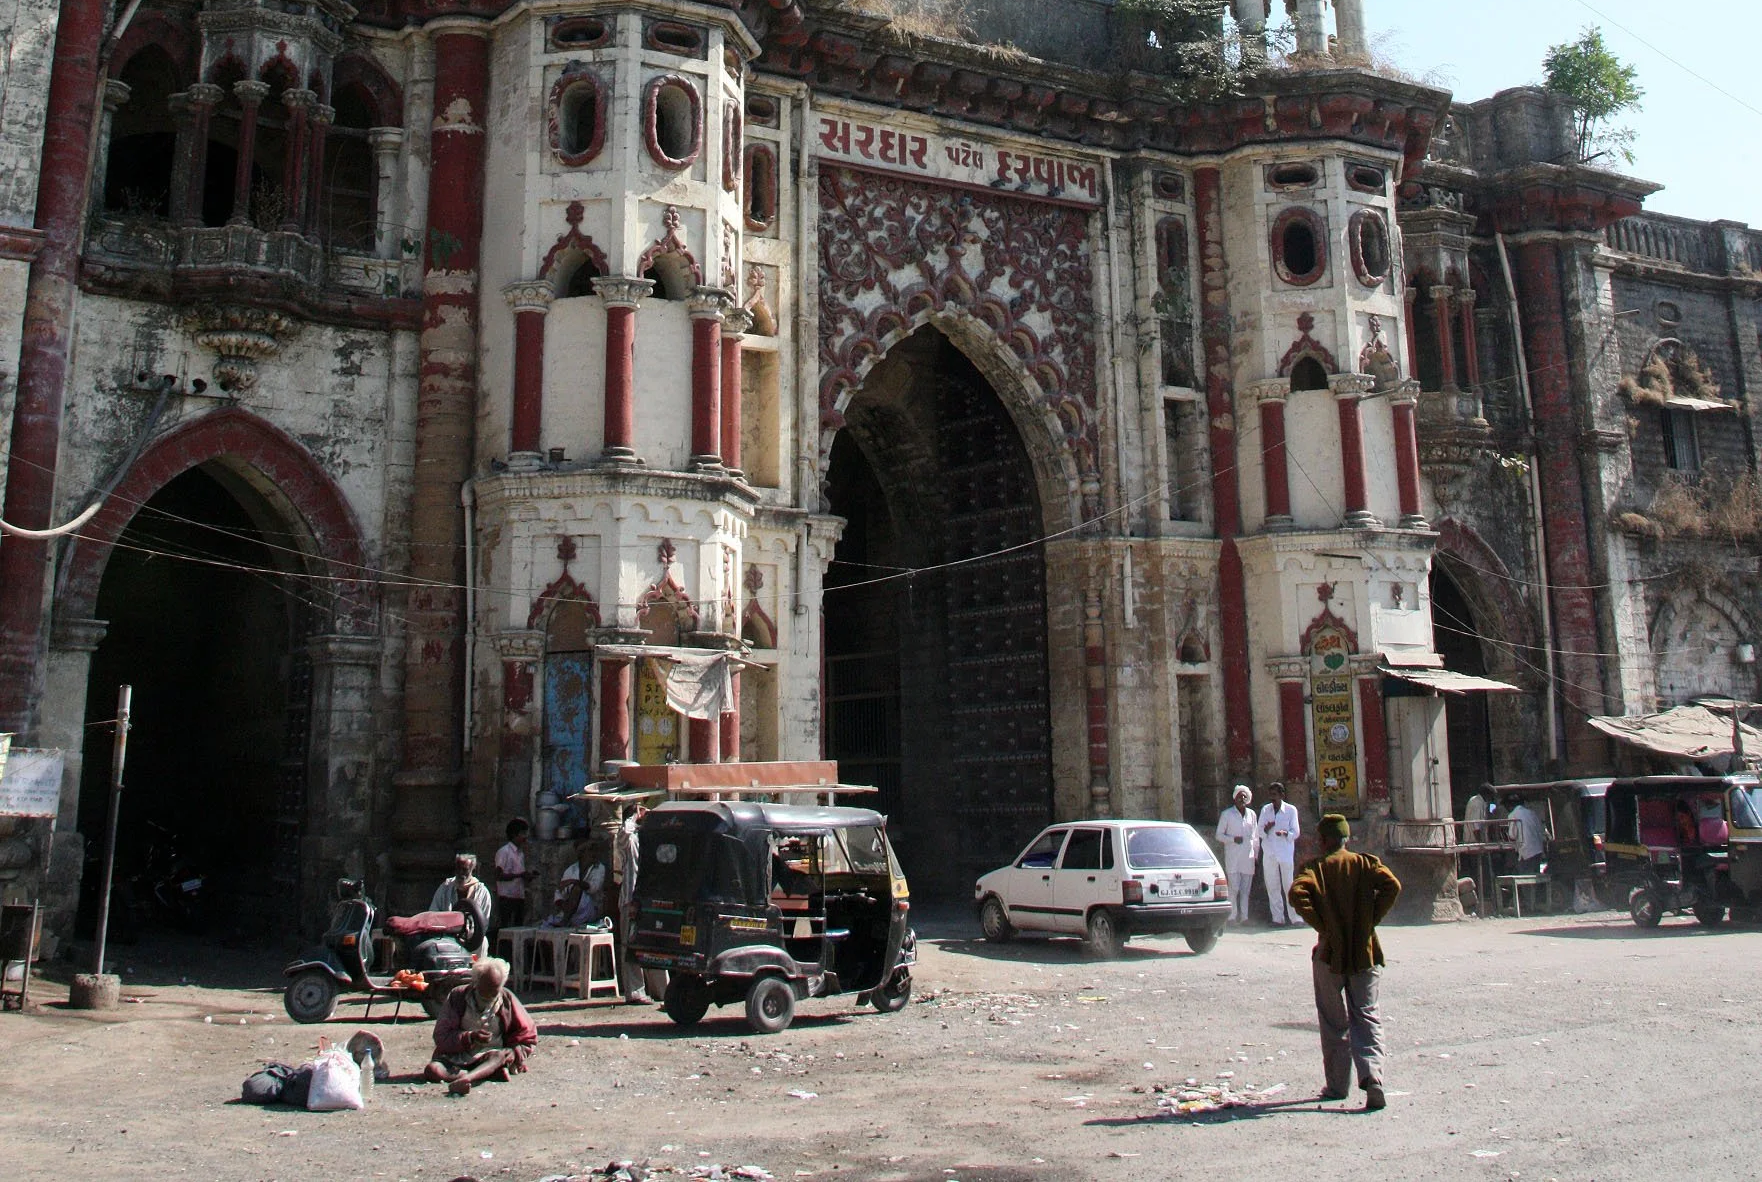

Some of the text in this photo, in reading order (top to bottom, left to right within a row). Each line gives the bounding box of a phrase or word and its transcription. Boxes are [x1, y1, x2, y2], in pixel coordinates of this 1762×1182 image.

[819, 118, 1097, 199] સરદાર પટેલ દરવાજા
[1323, 765, 1347, 779] STD
